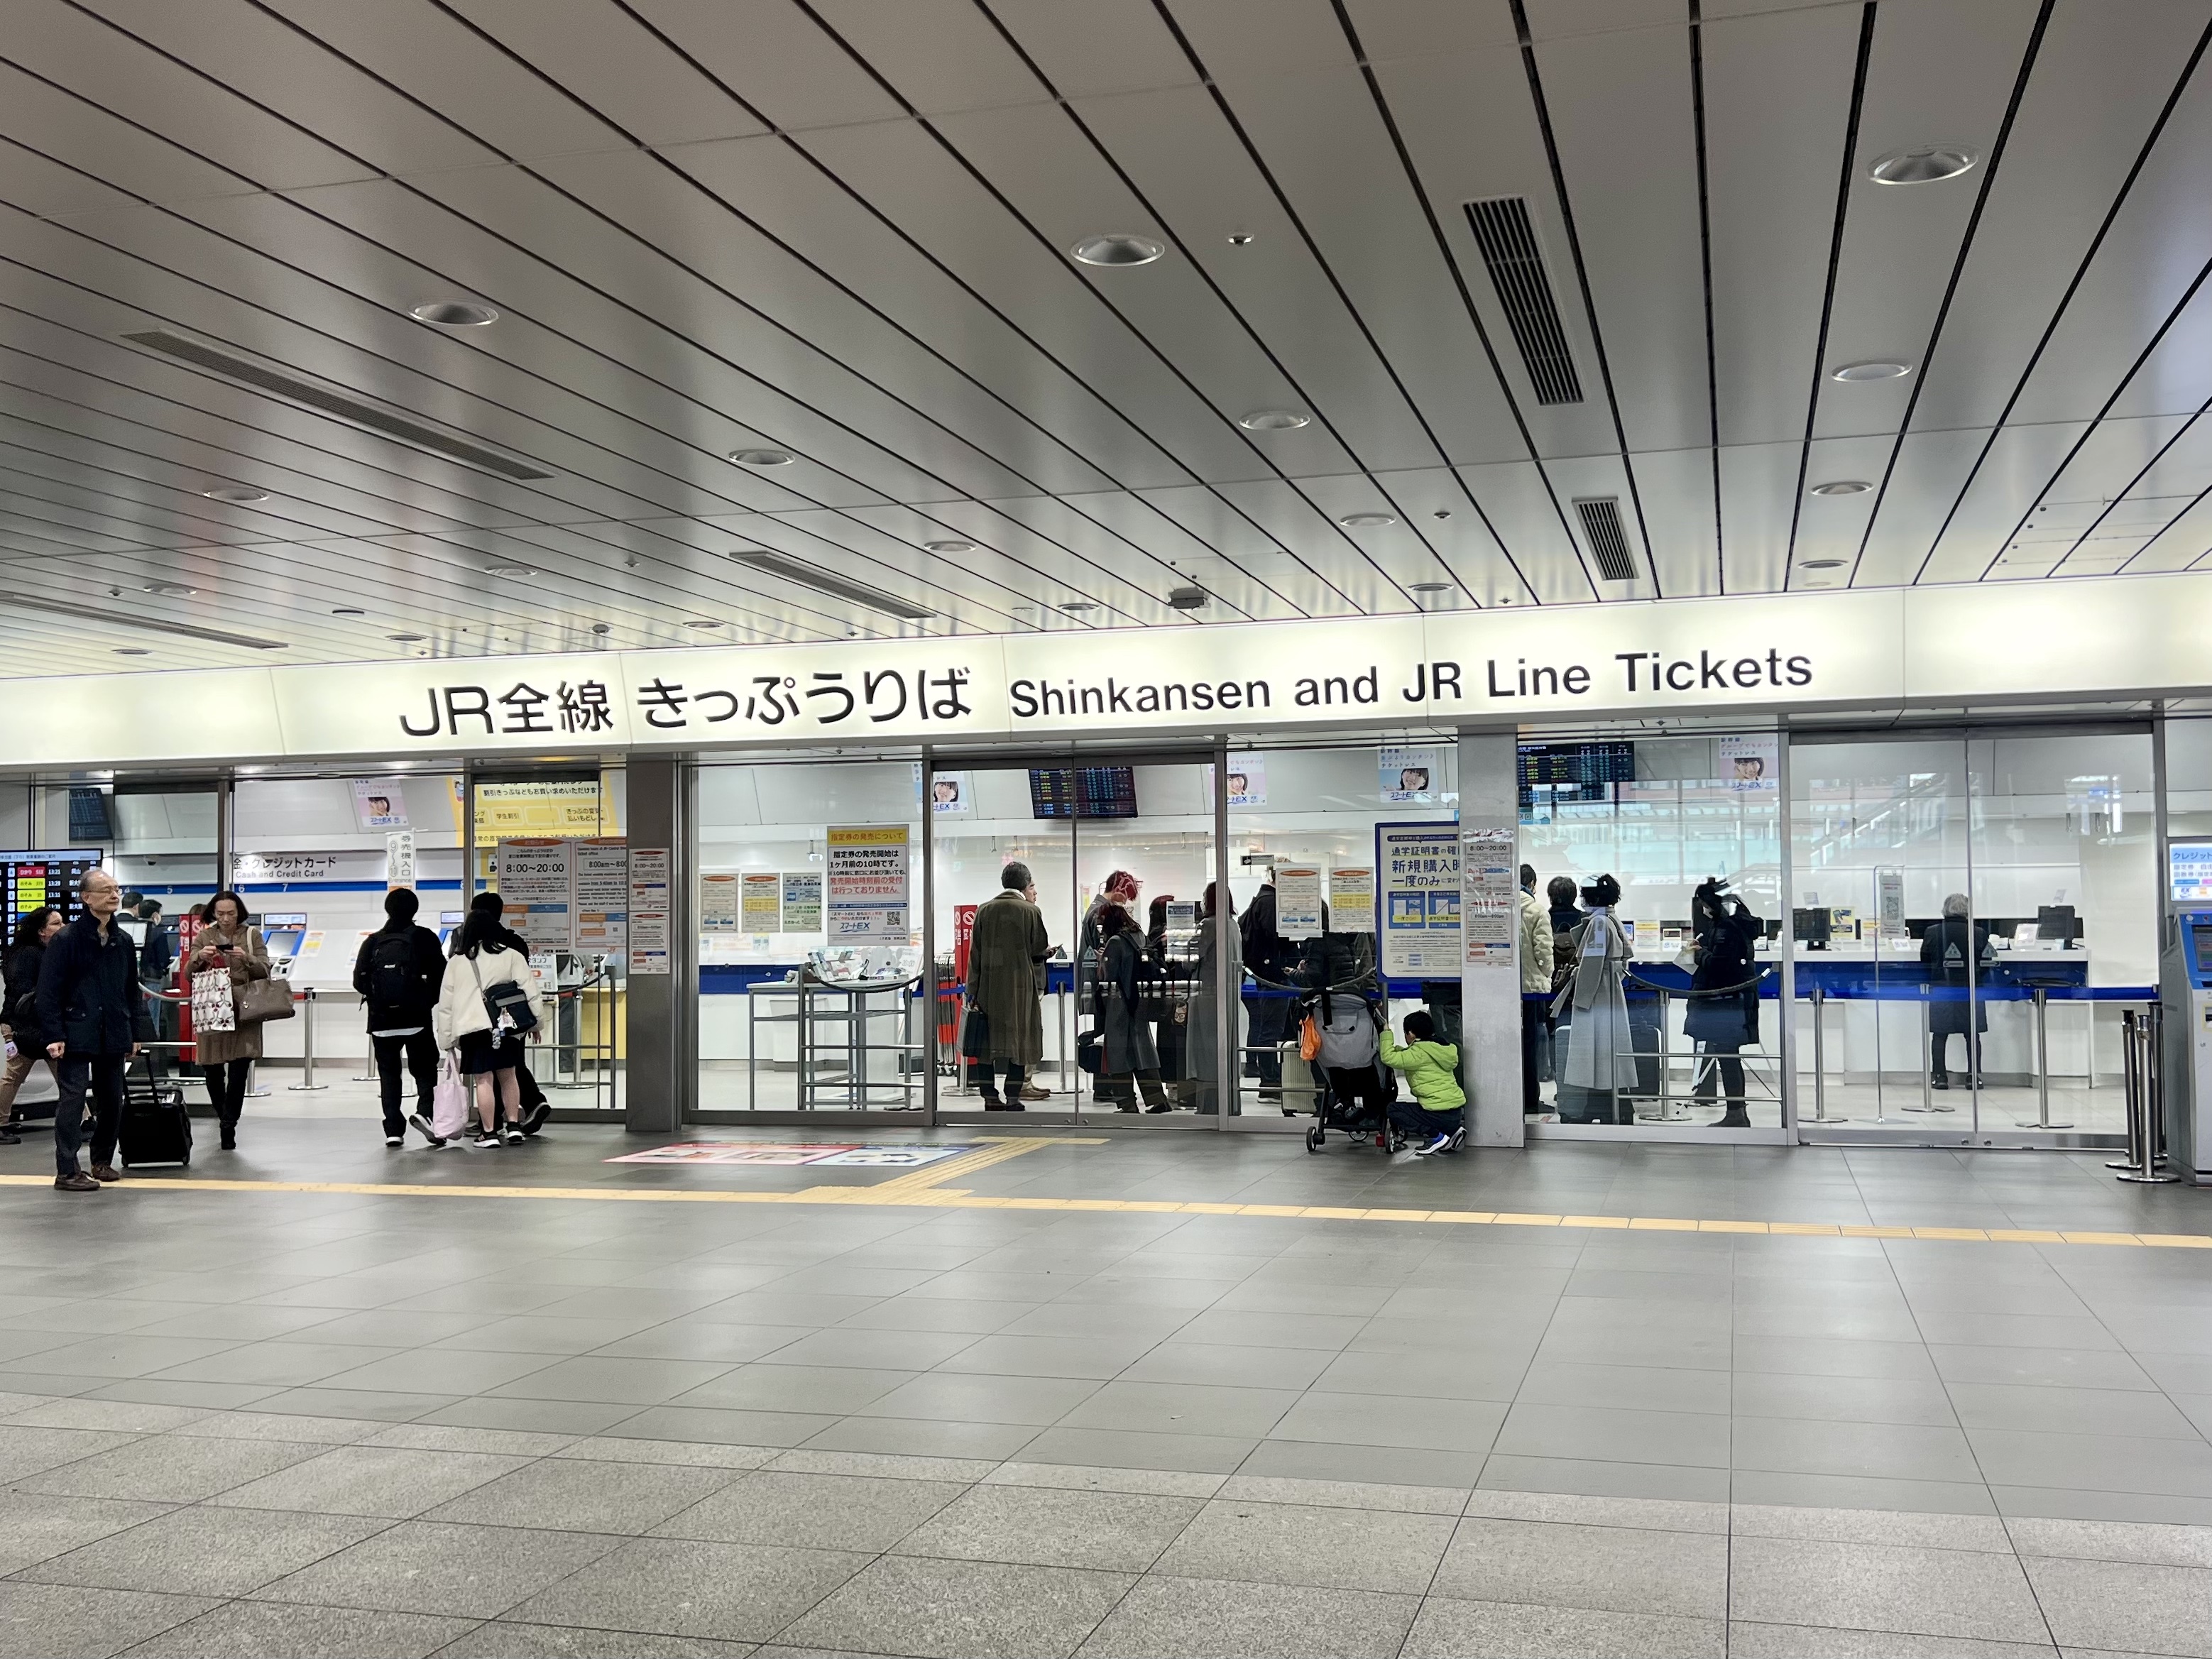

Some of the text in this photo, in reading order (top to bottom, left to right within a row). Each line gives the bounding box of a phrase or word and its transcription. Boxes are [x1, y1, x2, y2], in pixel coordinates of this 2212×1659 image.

[1011, 650, 1812, 718] Shinkansen and JR Line Tickets
[401, 668, 972, 737] JR全線 きっぷうりば
[831, 832, 904, 842] 指定券の発売について
[833, 849, 899, 859] 指定券の発売開始は
[1391, 845, 1460, 856] 通学証明書の確
[276, 870, 302, 878] Credit
[830, 876, 903, 886] 発売開始時刻前の受付
